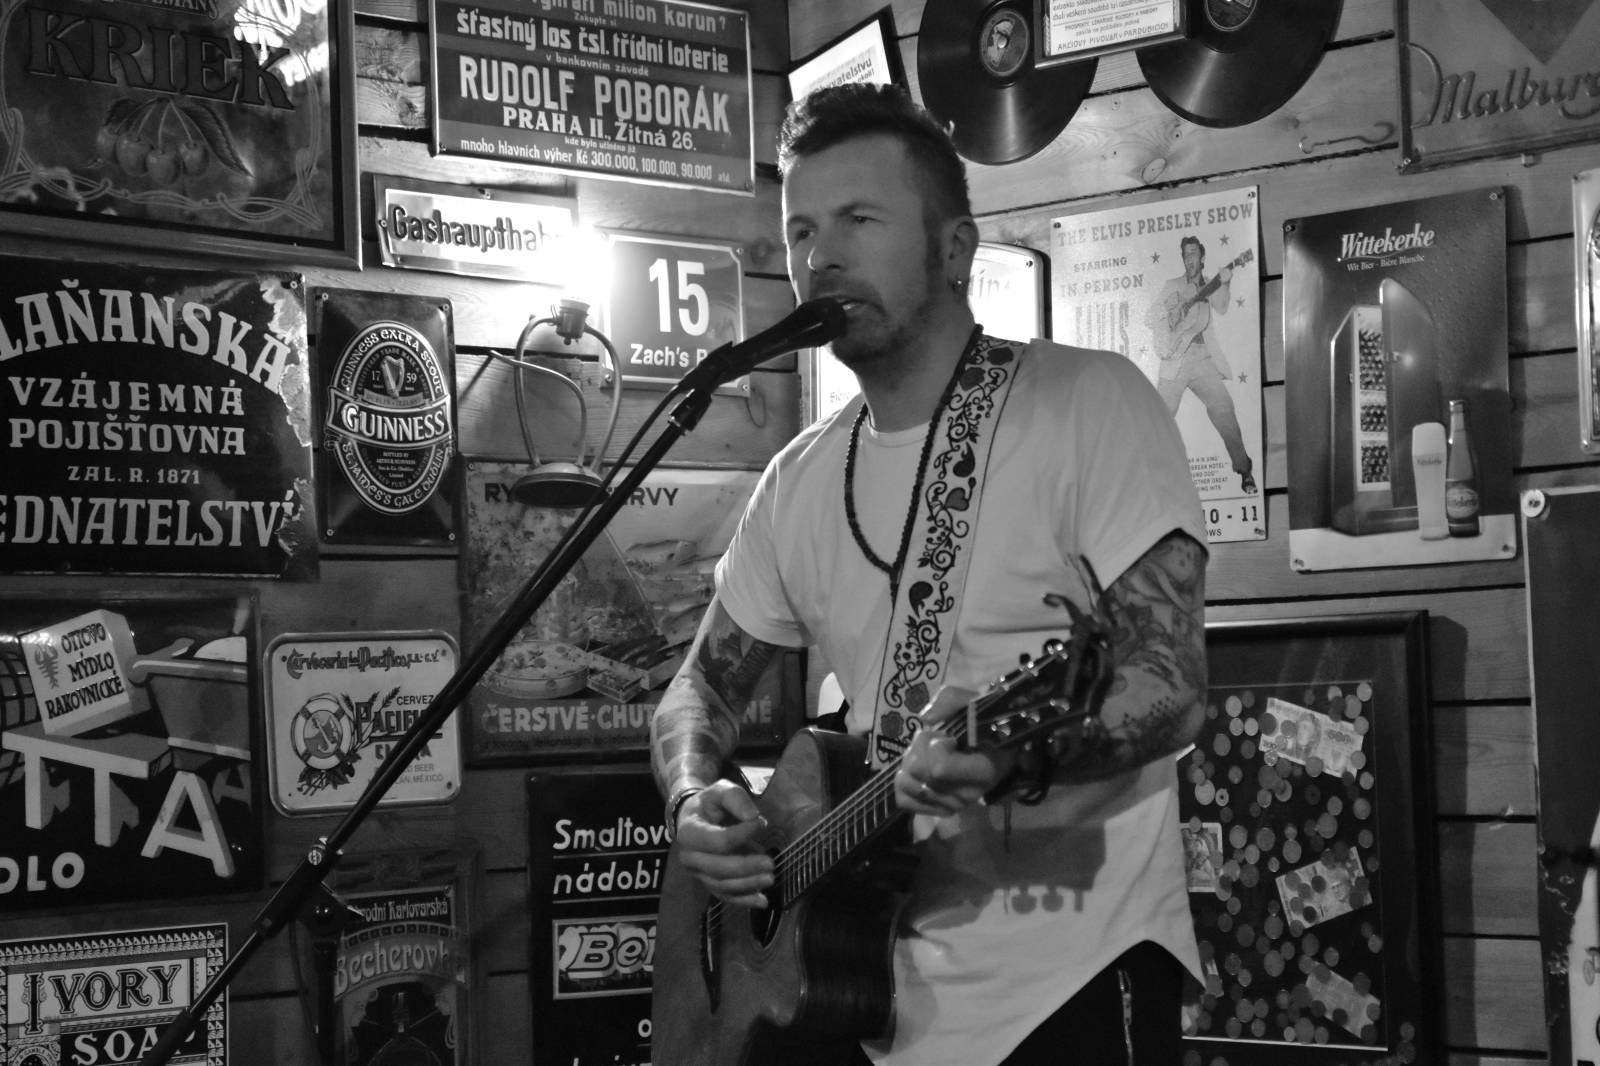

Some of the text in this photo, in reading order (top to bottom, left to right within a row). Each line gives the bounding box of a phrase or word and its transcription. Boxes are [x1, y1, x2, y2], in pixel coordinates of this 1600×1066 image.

[25, 7, 296, 111] KRIEK
[457, 7, 729, 73] šťastný los čsl. třídní loterie
[459, 55, 731, 135] RUDOLF POBORÁK
[503, 106, 584, 136] PRAHA
[614, 118, 667, 147] Žitná
[671, 130, 697, 151] 26.
[460, 137, 495, 153] mnoho
[543, 146, 573, 164] výher
[576, 149, 589, 164] Kč
[1058, 202, 1253, 248] THE ELVIS PRESLEY SHOW
[1340, 221, 1436, 260] Wittekerke
[1073, 256, 1128, 273] STARRING
[648, 257, 709, 337] 15
[1059, 273, 1144, 298] IN PERSON
[630, 343, 690, 368] Zach's
[8, 371, 245, 415] VZÁJEMNÁ
[371, 370, 417, 384] 17 59
[9, 413, 247, 455] POJIŠŤOVNA
[341, 403, 446, 442] GUINNESS
[67, 466, 200, 484] ZAL. R. 1871
[1241, 504, 1258, 522] 11
[67, 651, 115, 683] MÝDLO
[45, 669, 125, 719] RAKOVNICKÉ
[396, 694, 437, 706] CERVEZ
[22, 965, 182, 1035] IVORY
[72, 1026, 196, 1065] SOA
